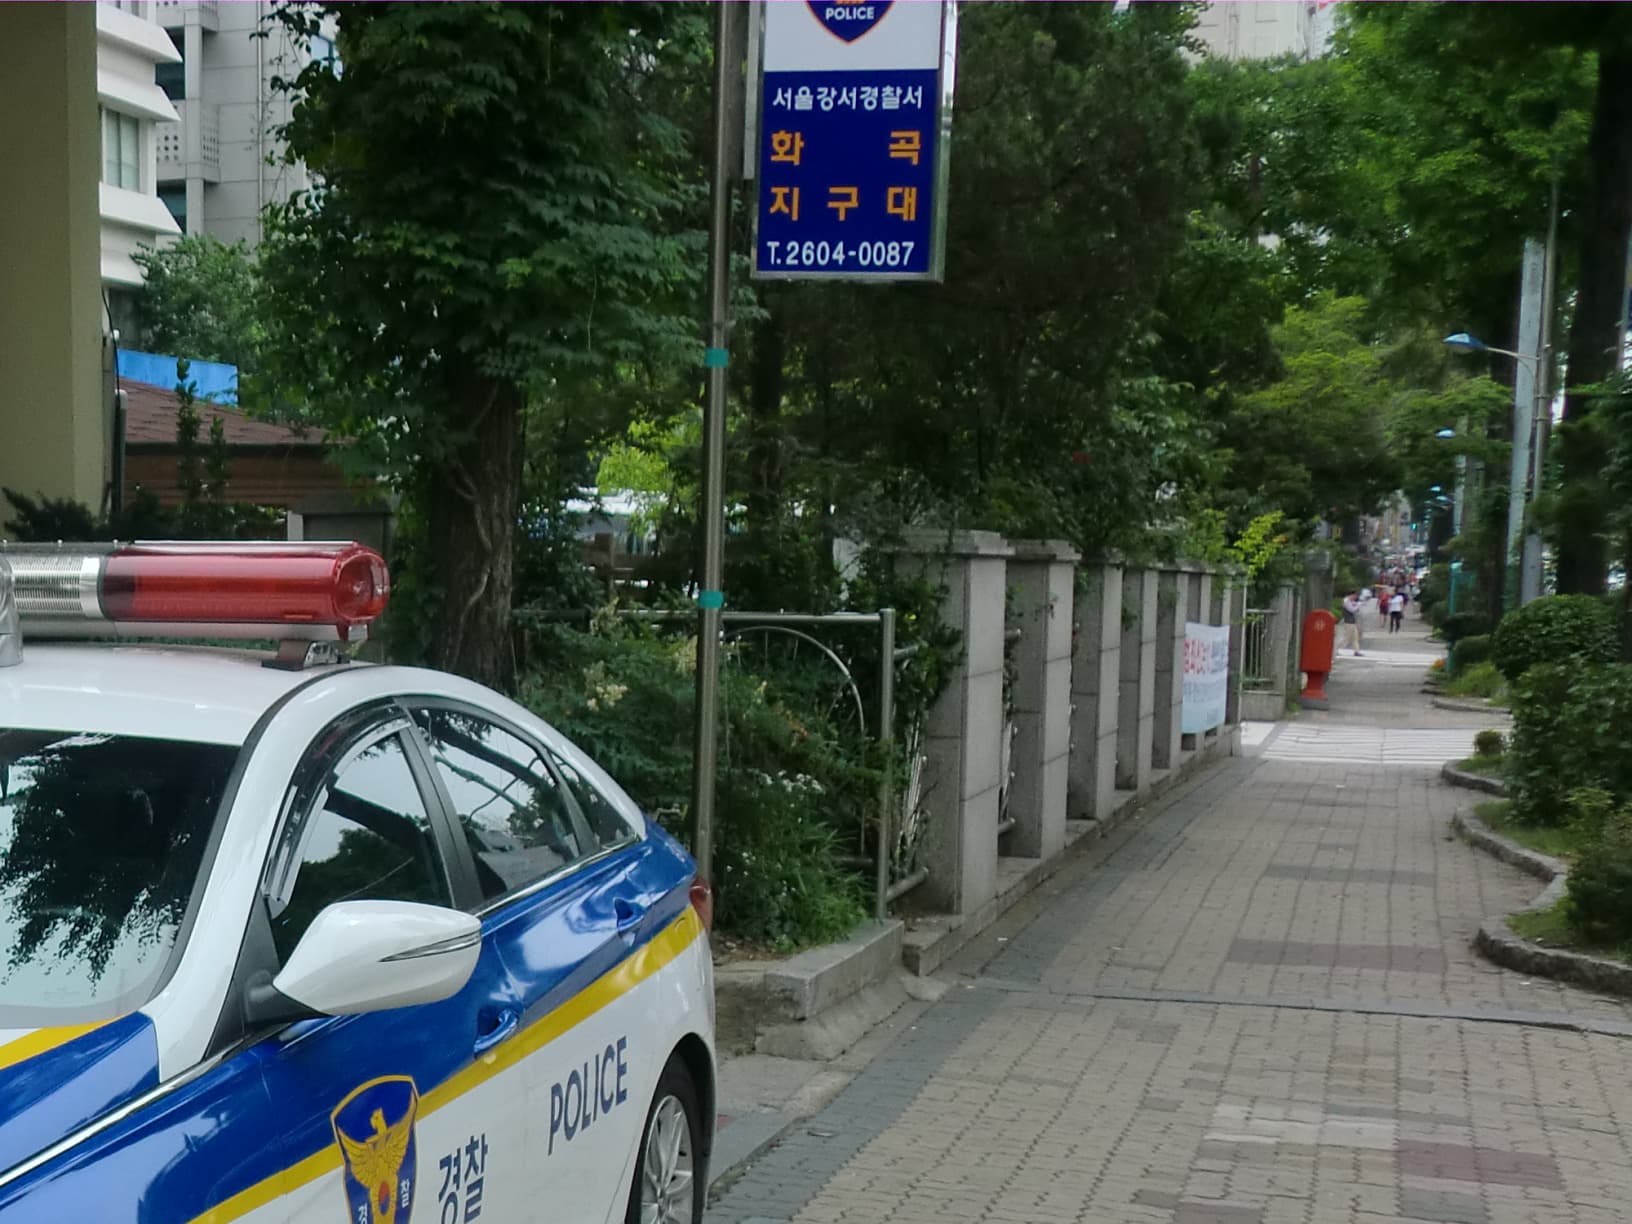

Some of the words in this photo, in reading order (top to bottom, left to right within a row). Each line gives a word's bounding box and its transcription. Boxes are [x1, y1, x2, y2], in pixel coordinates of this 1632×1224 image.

[825, 6, 875, 20] POLICE
[773, 85, 923, 111] 서울강서경찰서
[766, 241, 915, 266] T.2604-0087
[547, 1035, 628, 1156] POLICE
